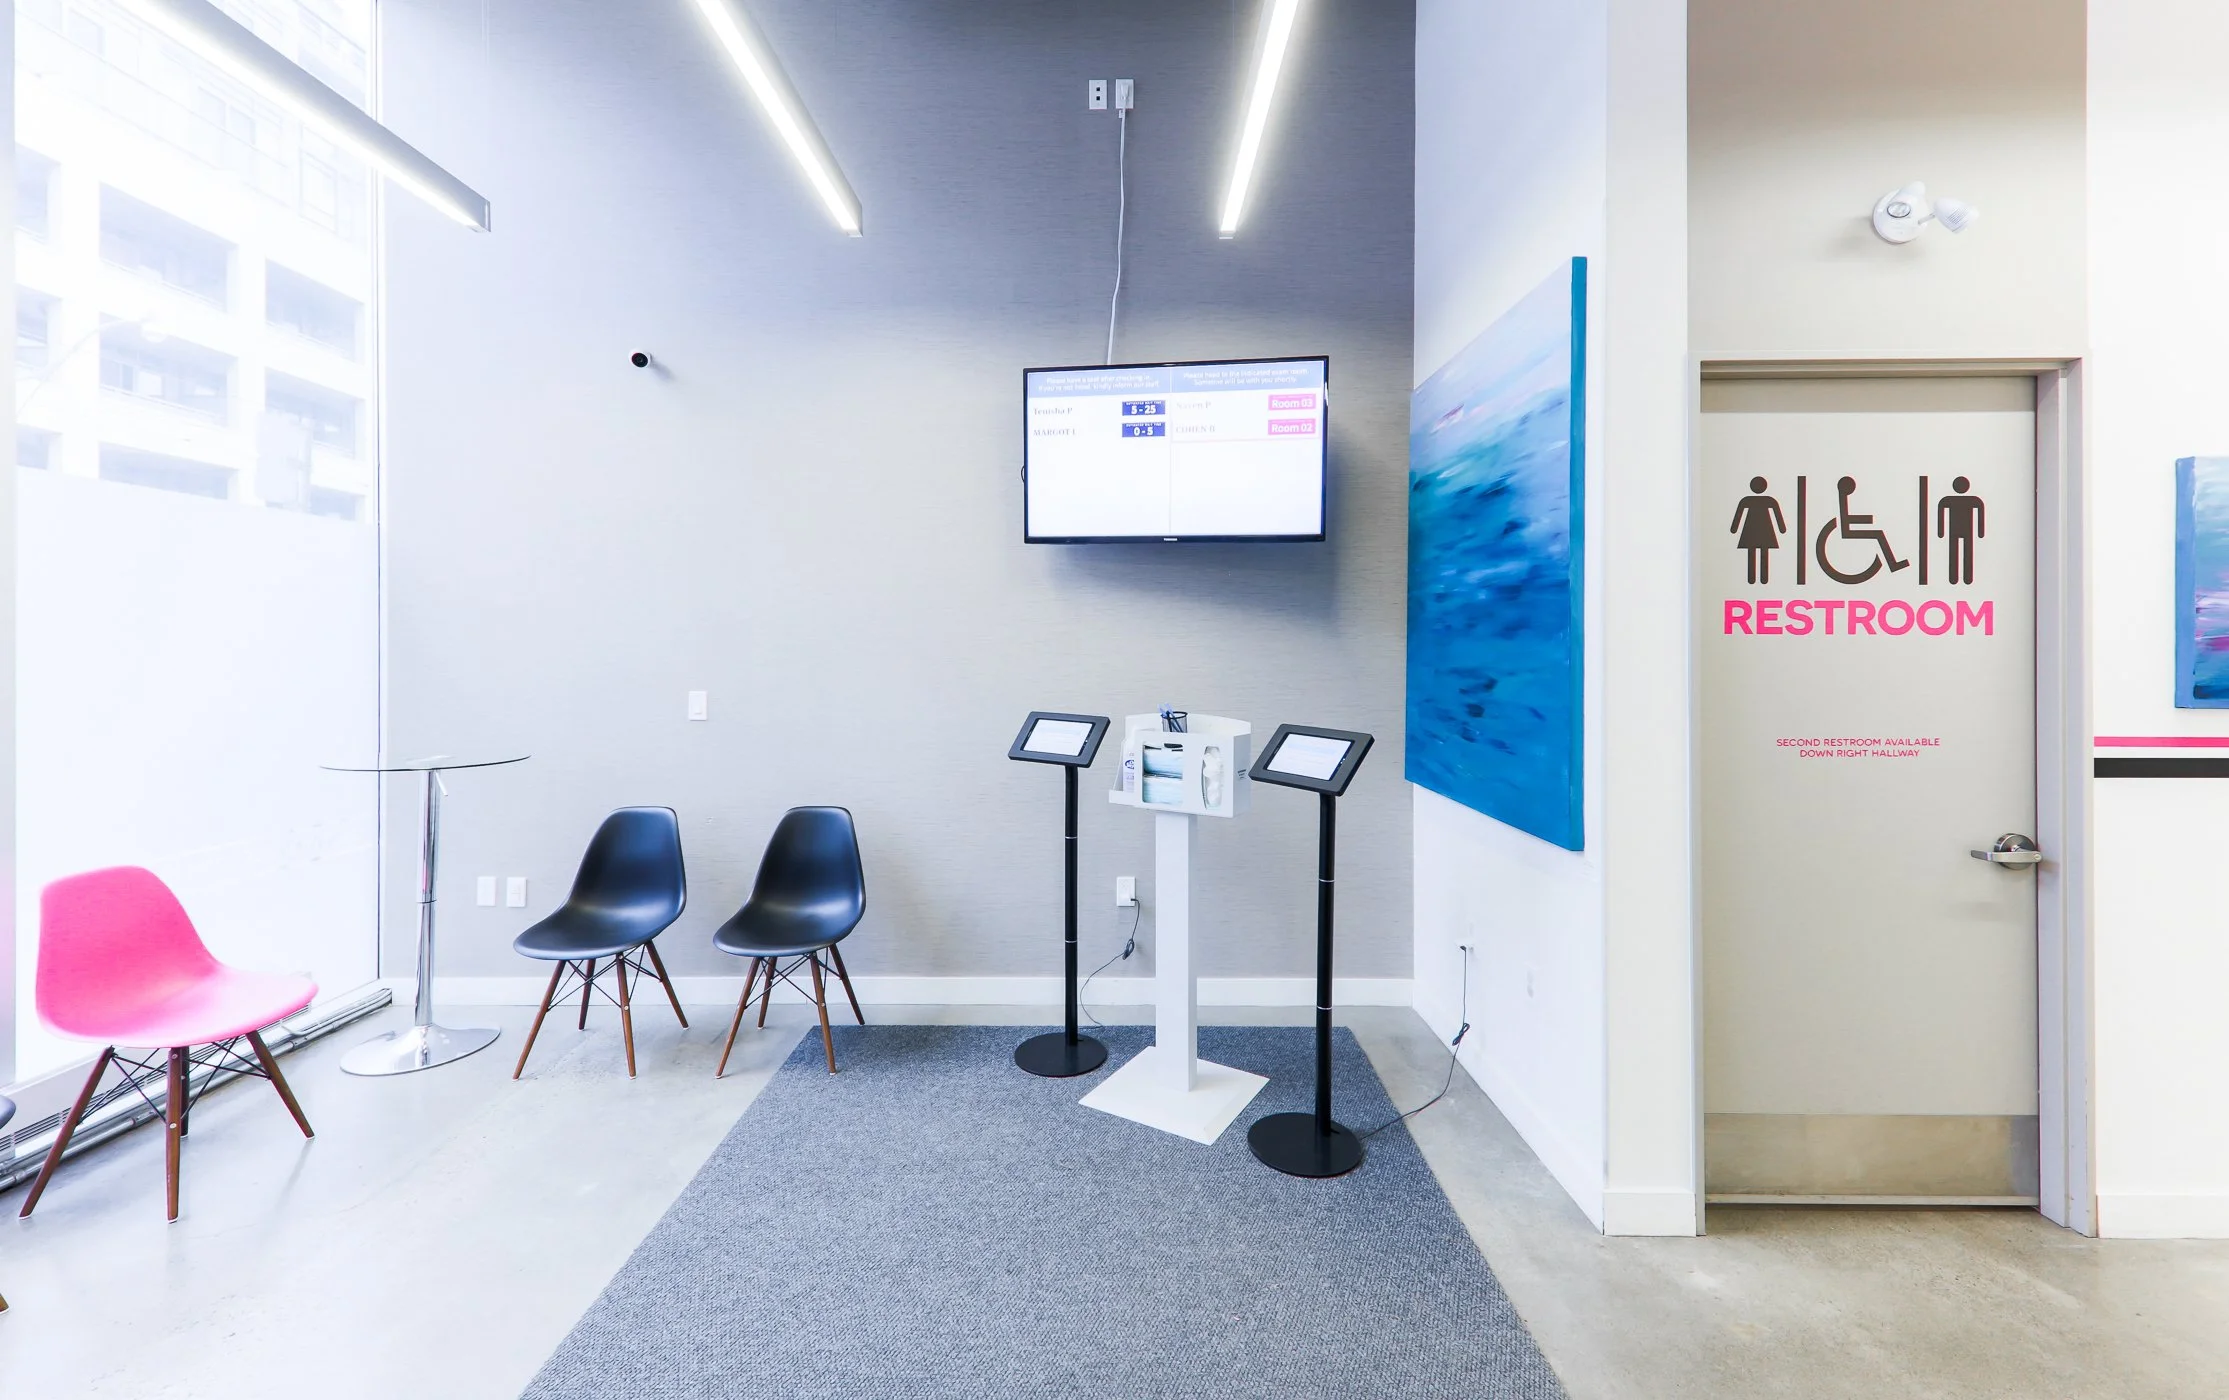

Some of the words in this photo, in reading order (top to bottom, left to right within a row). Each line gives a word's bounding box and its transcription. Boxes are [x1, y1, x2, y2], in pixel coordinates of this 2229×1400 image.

[1131, 405, 1138, 415] 5
[1144, 404, 1156, 415] 25
[1271, 399, 1300, 409] Room
[1133, 426, 1141, 437] 0
[1146, 426, 1154, 436] 5
[1271, 423, 1300, 433] Room
[1300, 422, 1313, 432] 02
[1724, 599, 1994, 636] RESTROOM
[1776, 738, 1821, 747] SECOND
[1823, 738, 1881, 747] RESTROOM
[1884, 737, 1941, 747] AVAILABLE
[1799, 749, 1834, 758] DOWN
[1836, 749, 1869, 758] RIGHT
[1871, 749, 1920, 758] HALLWAY
